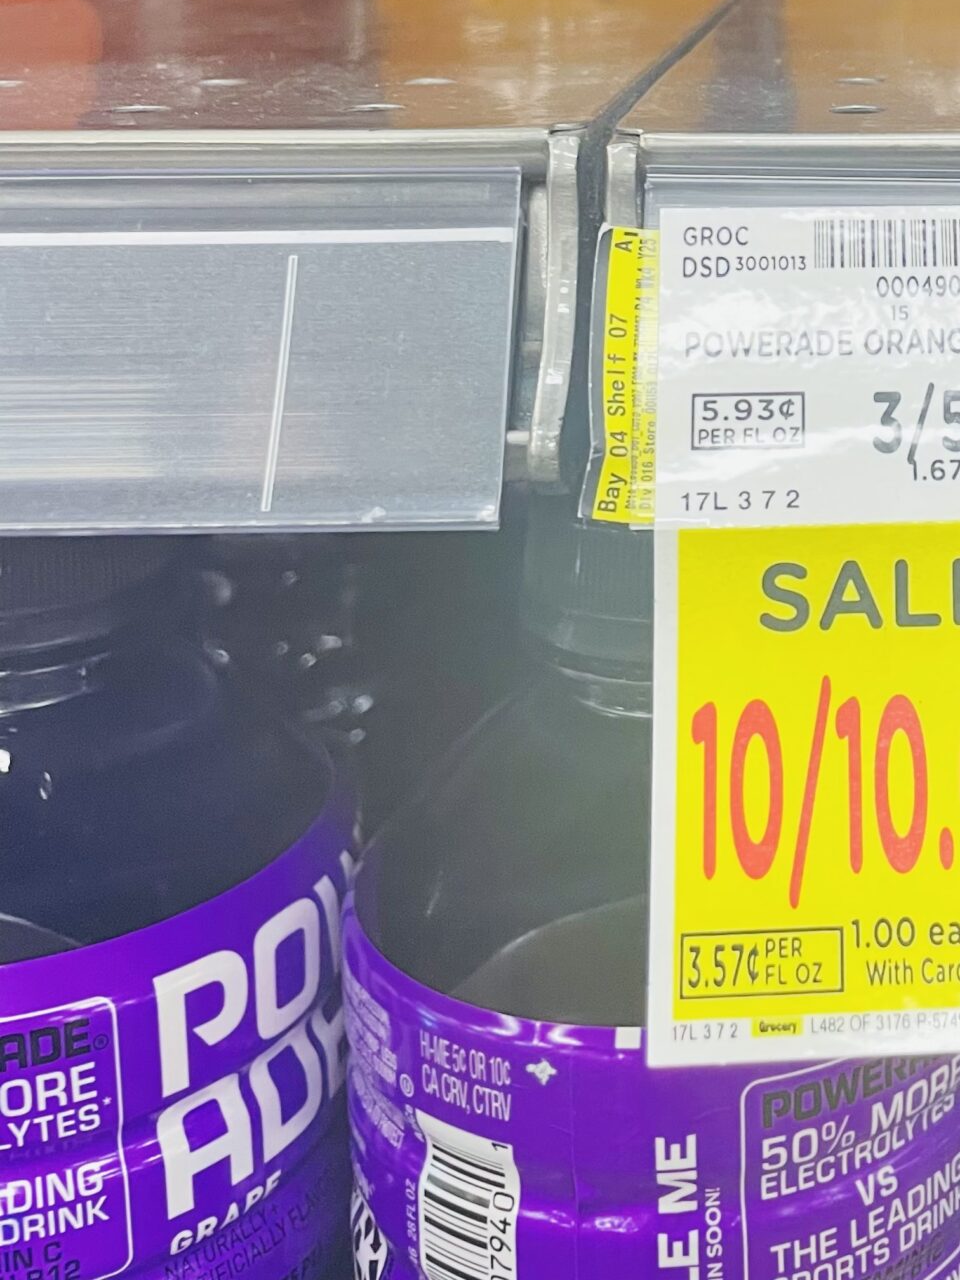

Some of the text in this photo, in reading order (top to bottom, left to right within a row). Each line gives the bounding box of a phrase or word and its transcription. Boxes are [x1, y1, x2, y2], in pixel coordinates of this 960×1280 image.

[683, 227, 749, 246] GROC
[682, 256, 807, 278] DSD 3001013
[608, 313, 628, 338] 07
[891, 304, 909, 321] 15
[684, 329, 853, 358] POWERADE
[606, 353, 626, 417] Shelf
[702, 398, 796, 421] 5.93¢
[610, 431, 629, 457] 04
[698, 427, 801, 445] PER FL OZ
[597, 473, 628, 513] Bay
[682, 490, 800, 511] 17L 3 7 2
[766, 937, 802, 959] PER
[851, 918, 916, 949] 1.00
[687, 943, 760, 989] 3.57¢
[766, 962, 823, 985] FL OZ
[866, 959, 914, 986] With
[673, 1024, 697, 1041] 17L
[759, 1021, 796, 1034] Grocery
[811, 1016, 845, 1033] L482
[850, 1015, 870, 1032] OF
[420, 1029, 451, 1070] HI-ME
[469, 1049, 487, 1082] OR
[422, 1063, 440, 1098] CA
[473, 1084, 512, 1122] CTRV
[760, 1093, 955, 1201] ELECTROLYTES
[761, 1115, 855, 1171] 50%
[655, 1133, 698, 1214] ME
[856, 1164, 898, 1206] VS
[0, 1195, 110, 1247] DRINK
[170, 1169, 282, 1256] GRAPE
[705, 1187, 722, 1259] SOON!
[770, 1227, 838, 1274] THE
